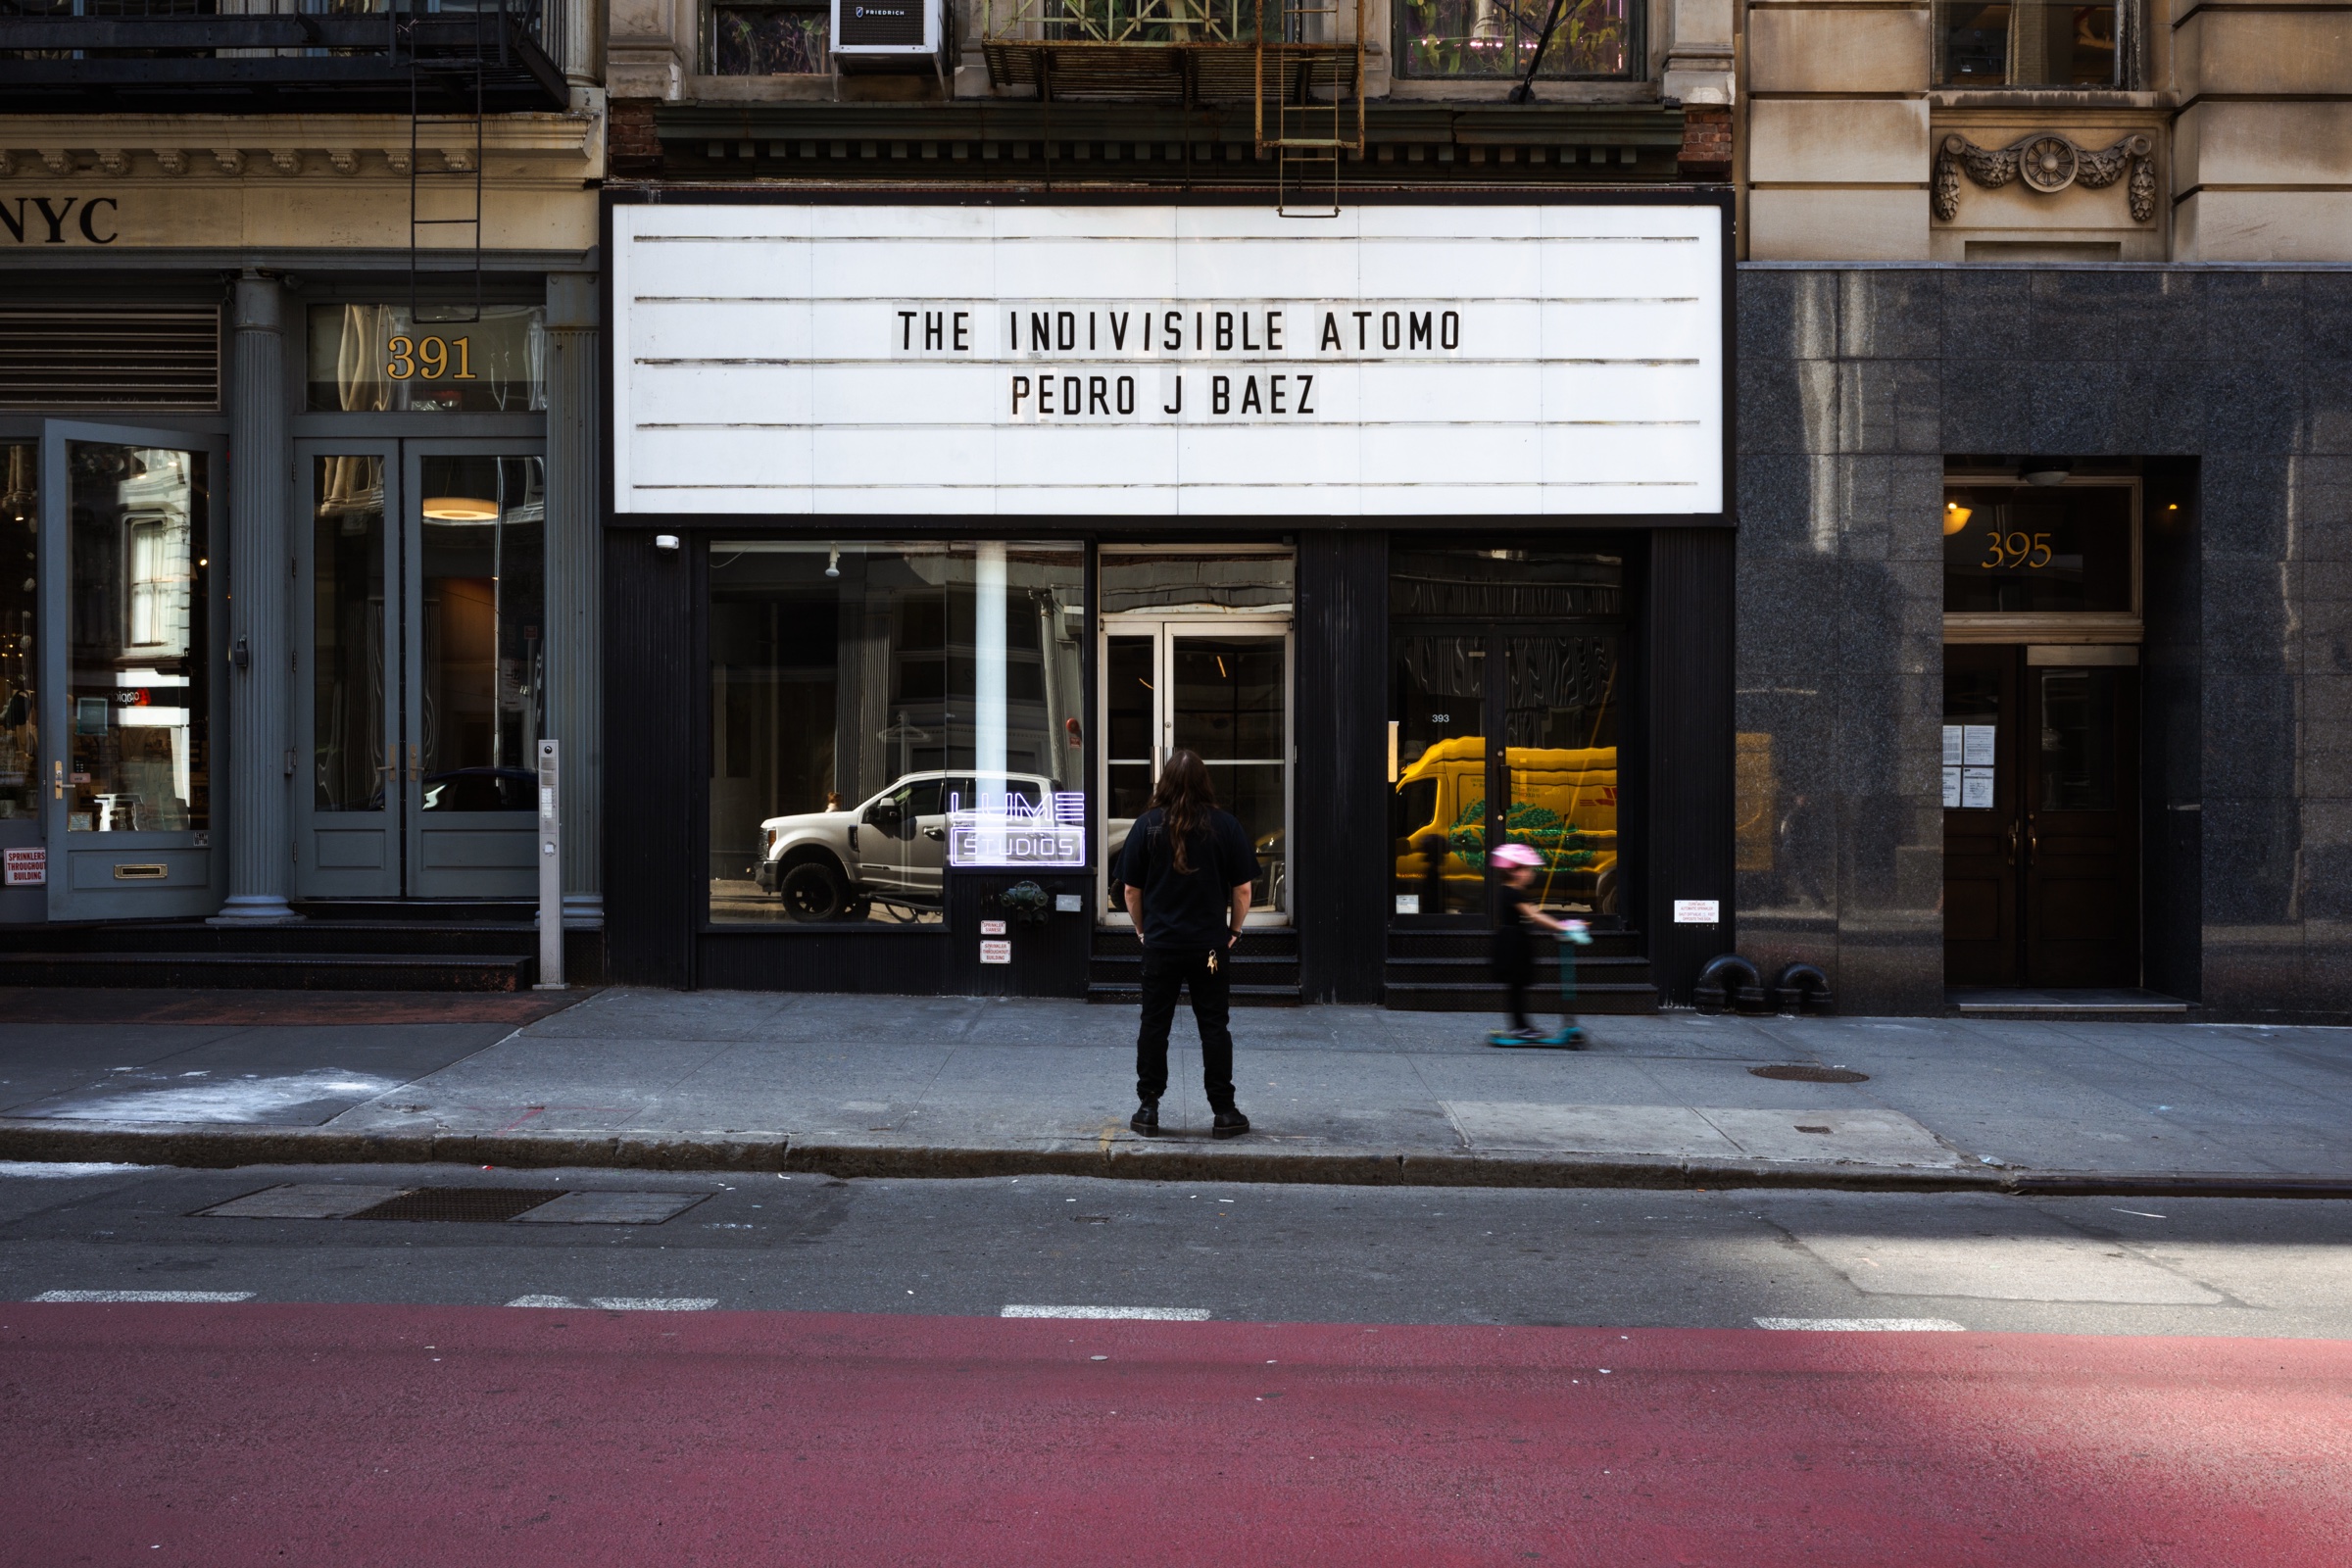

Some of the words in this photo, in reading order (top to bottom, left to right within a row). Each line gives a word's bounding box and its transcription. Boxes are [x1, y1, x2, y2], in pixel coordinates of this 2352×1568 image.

[899, 311, 969, 351] THE
[1010, 311, 1283, 352] INDIVISIBLE
[1321, 311, 1460, 351] ATOMO
[387, 336, 477, 380] 391
[1012, 374, 1135, 416] PEDRO
[1163, 375, 1182, 415] J
[1212, 374, 1314, 415] BAEZ
[1982, 531, 2052, 569] 395
[1432, 713, 1450, 723] 393
[951, 792, 1085, 821] LUME
[8, 852, 46, 861] SPRINKLERS
[963, 838, 1074, 856] STUDIOS
[7, 861, 47, 871] THROUGHOUT
[14, 871, 42, 881] BUILDING
